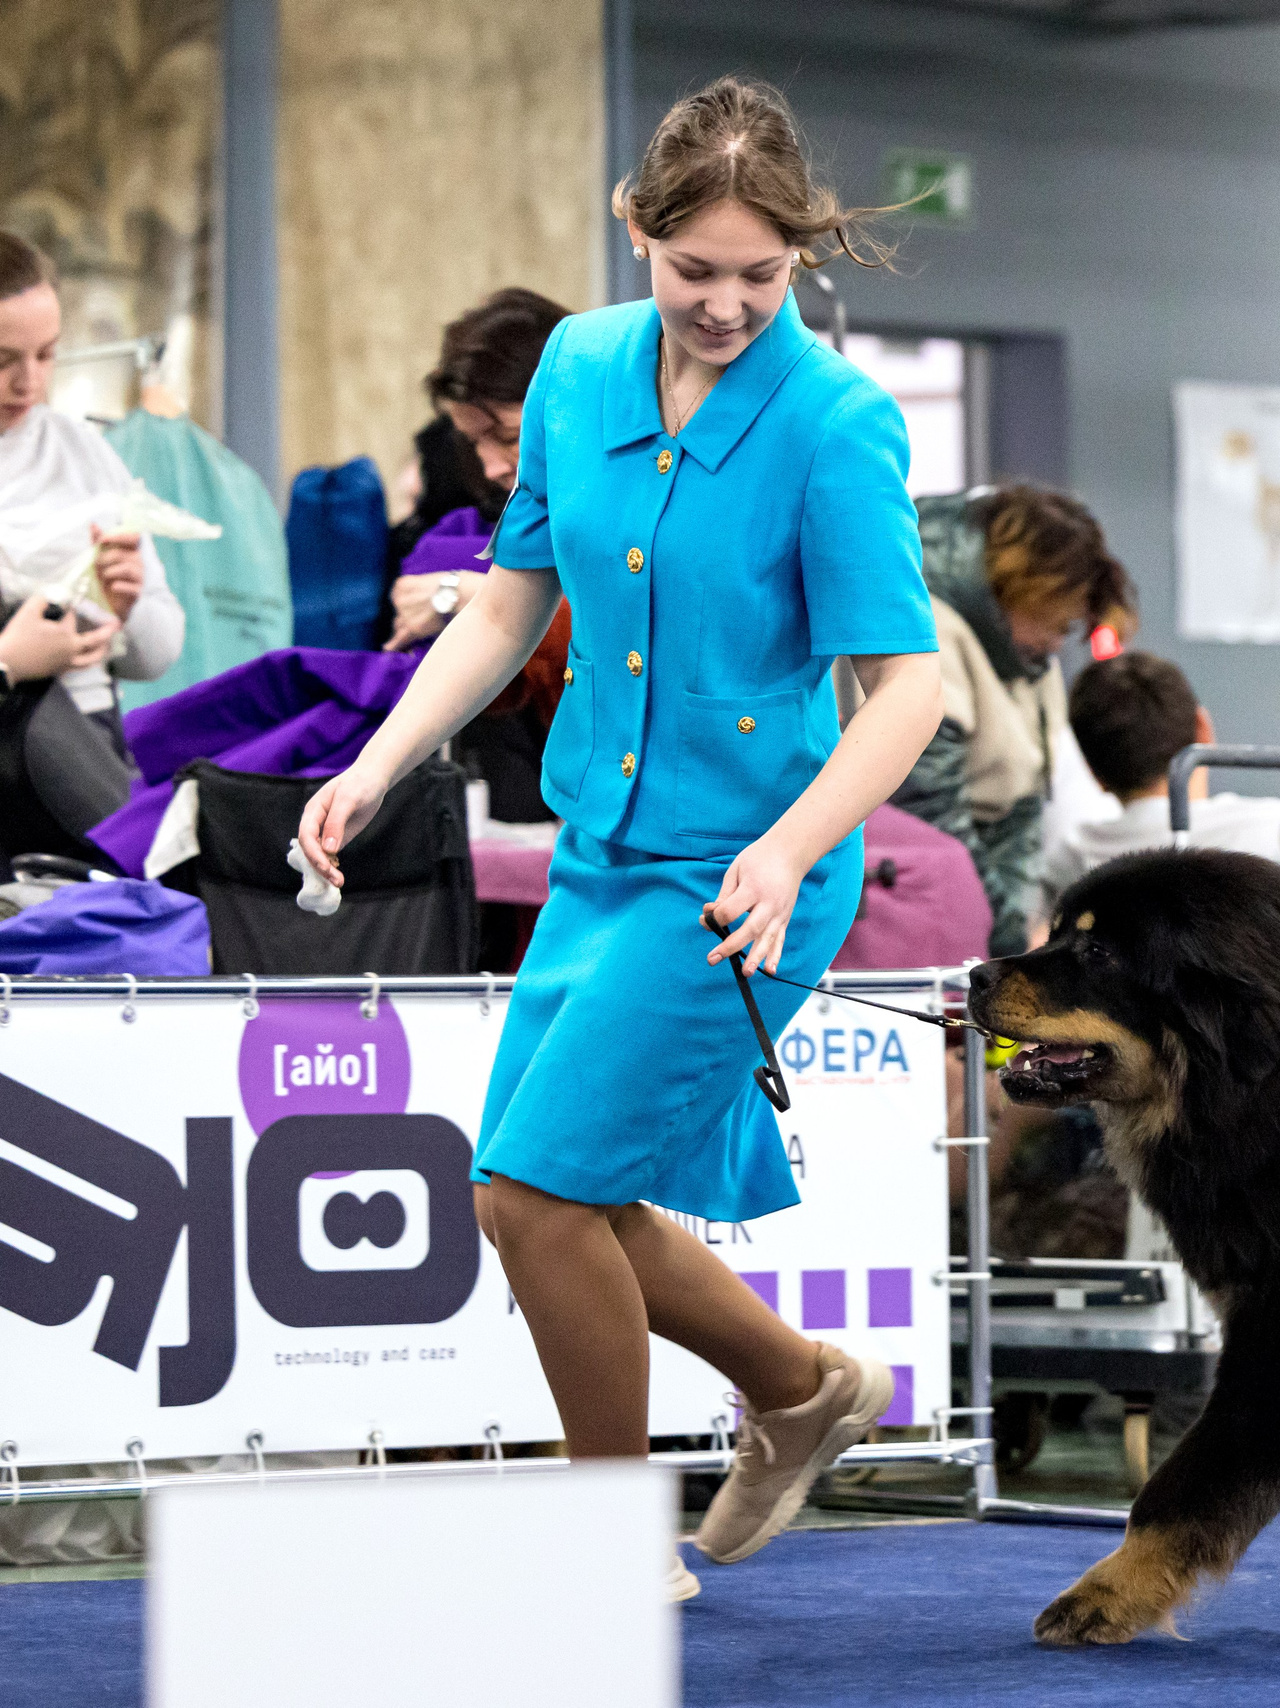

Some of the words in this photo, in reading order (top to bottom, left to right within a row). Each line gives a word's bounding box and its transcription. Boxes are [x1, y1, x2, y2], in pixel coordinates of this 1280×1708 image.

[781, 1027, 910, 1074] ФЕРА
[274, 1346, 369, 1367] technology
[381, 1345, 409, 1362] and
[419, 1345, 457, 1361] care
